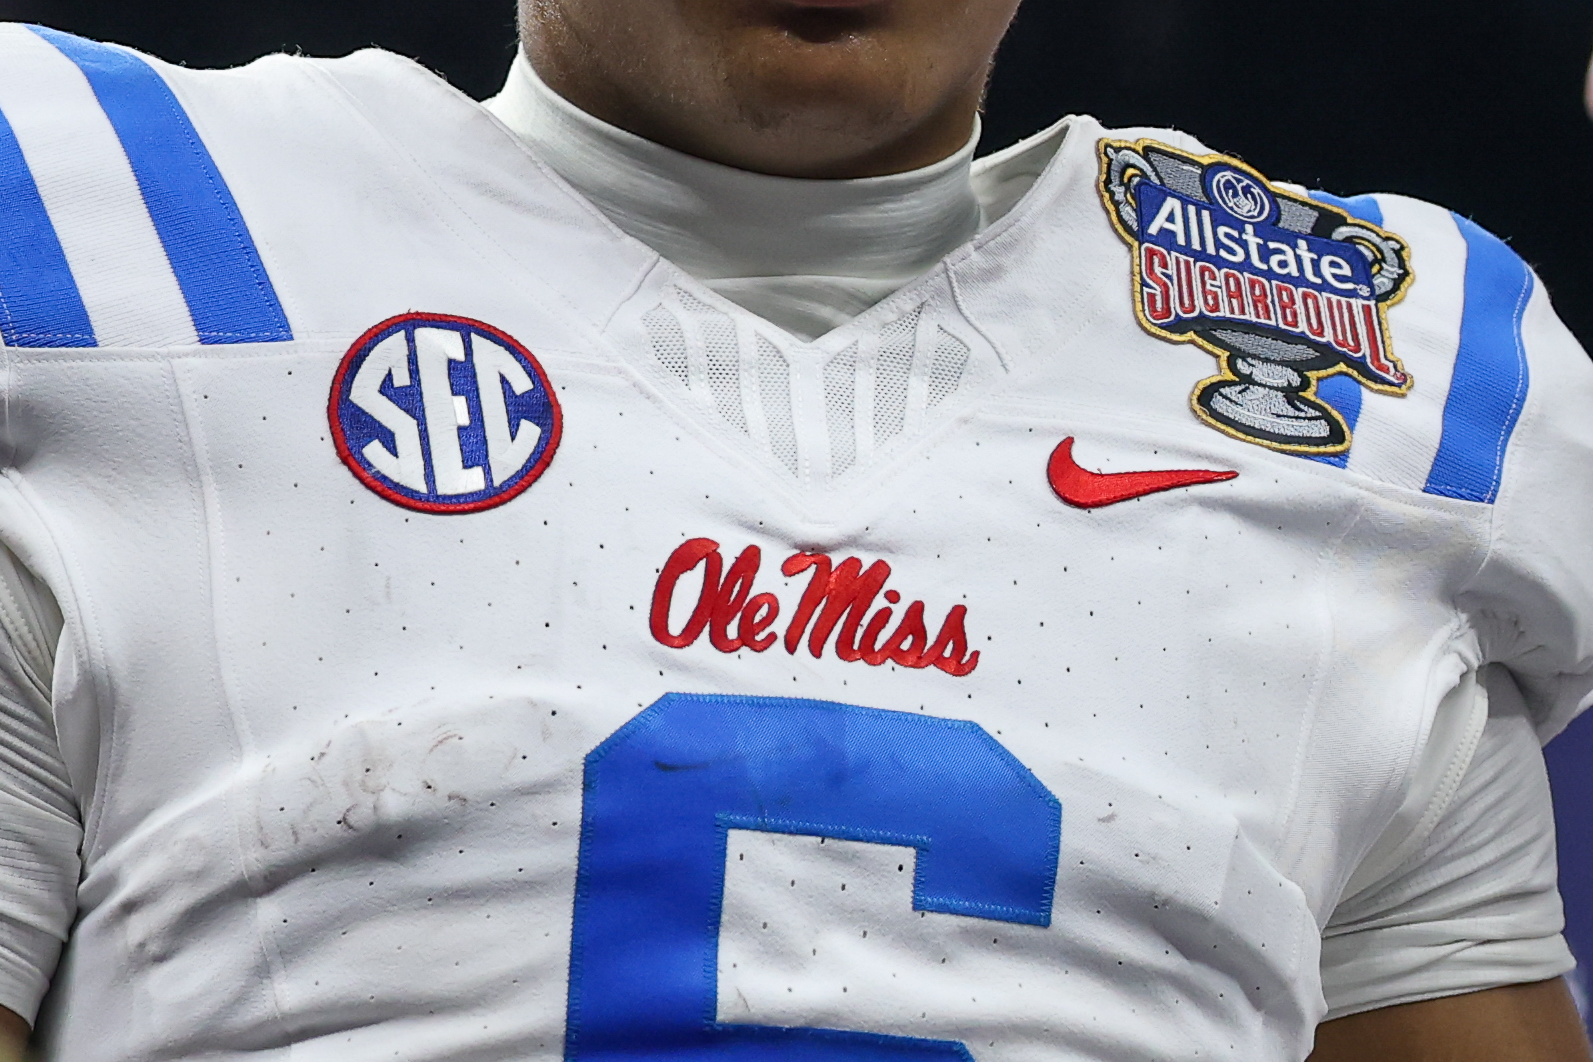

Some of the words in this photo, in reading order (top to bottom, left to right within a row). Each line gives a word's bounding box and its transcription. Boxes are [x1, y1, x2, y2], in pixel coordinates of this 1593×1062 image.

[1148, 196, 1355, 290] Allstate
[348, 327, 542, 496] SEC
[648, 538, 778, 654] Ole
[780, 552, 980, 676] Miss
